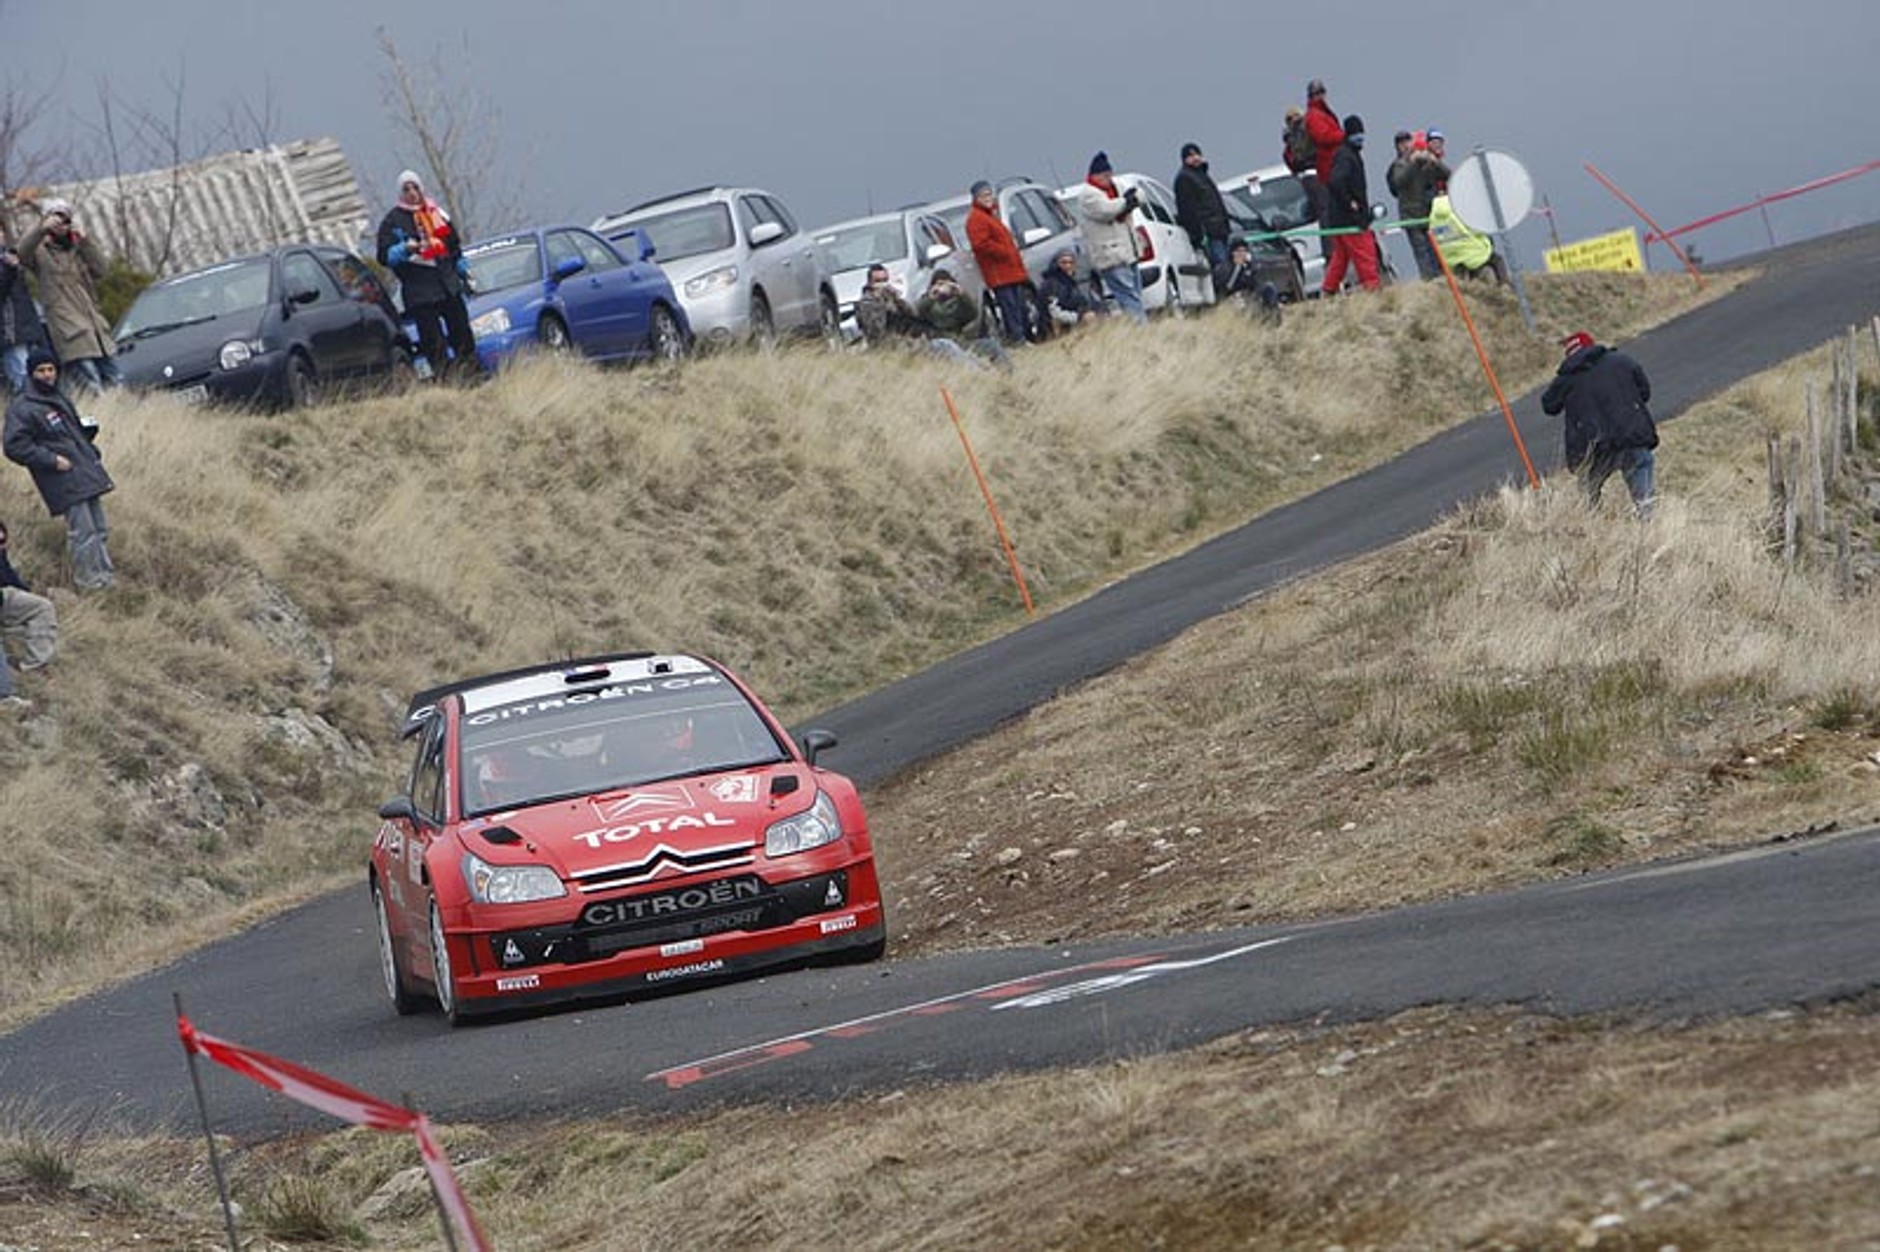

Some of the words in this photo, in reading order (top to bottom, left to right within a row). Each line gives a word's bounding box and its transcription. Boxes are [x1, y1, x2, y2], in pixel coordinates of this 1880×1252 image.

[467, 684, 653, 725] CITROËN
[661, 677, 721, 690] C4
[572, 812, 736, 848] TOTAL
[584, 878, 761, 925] CITROËN
